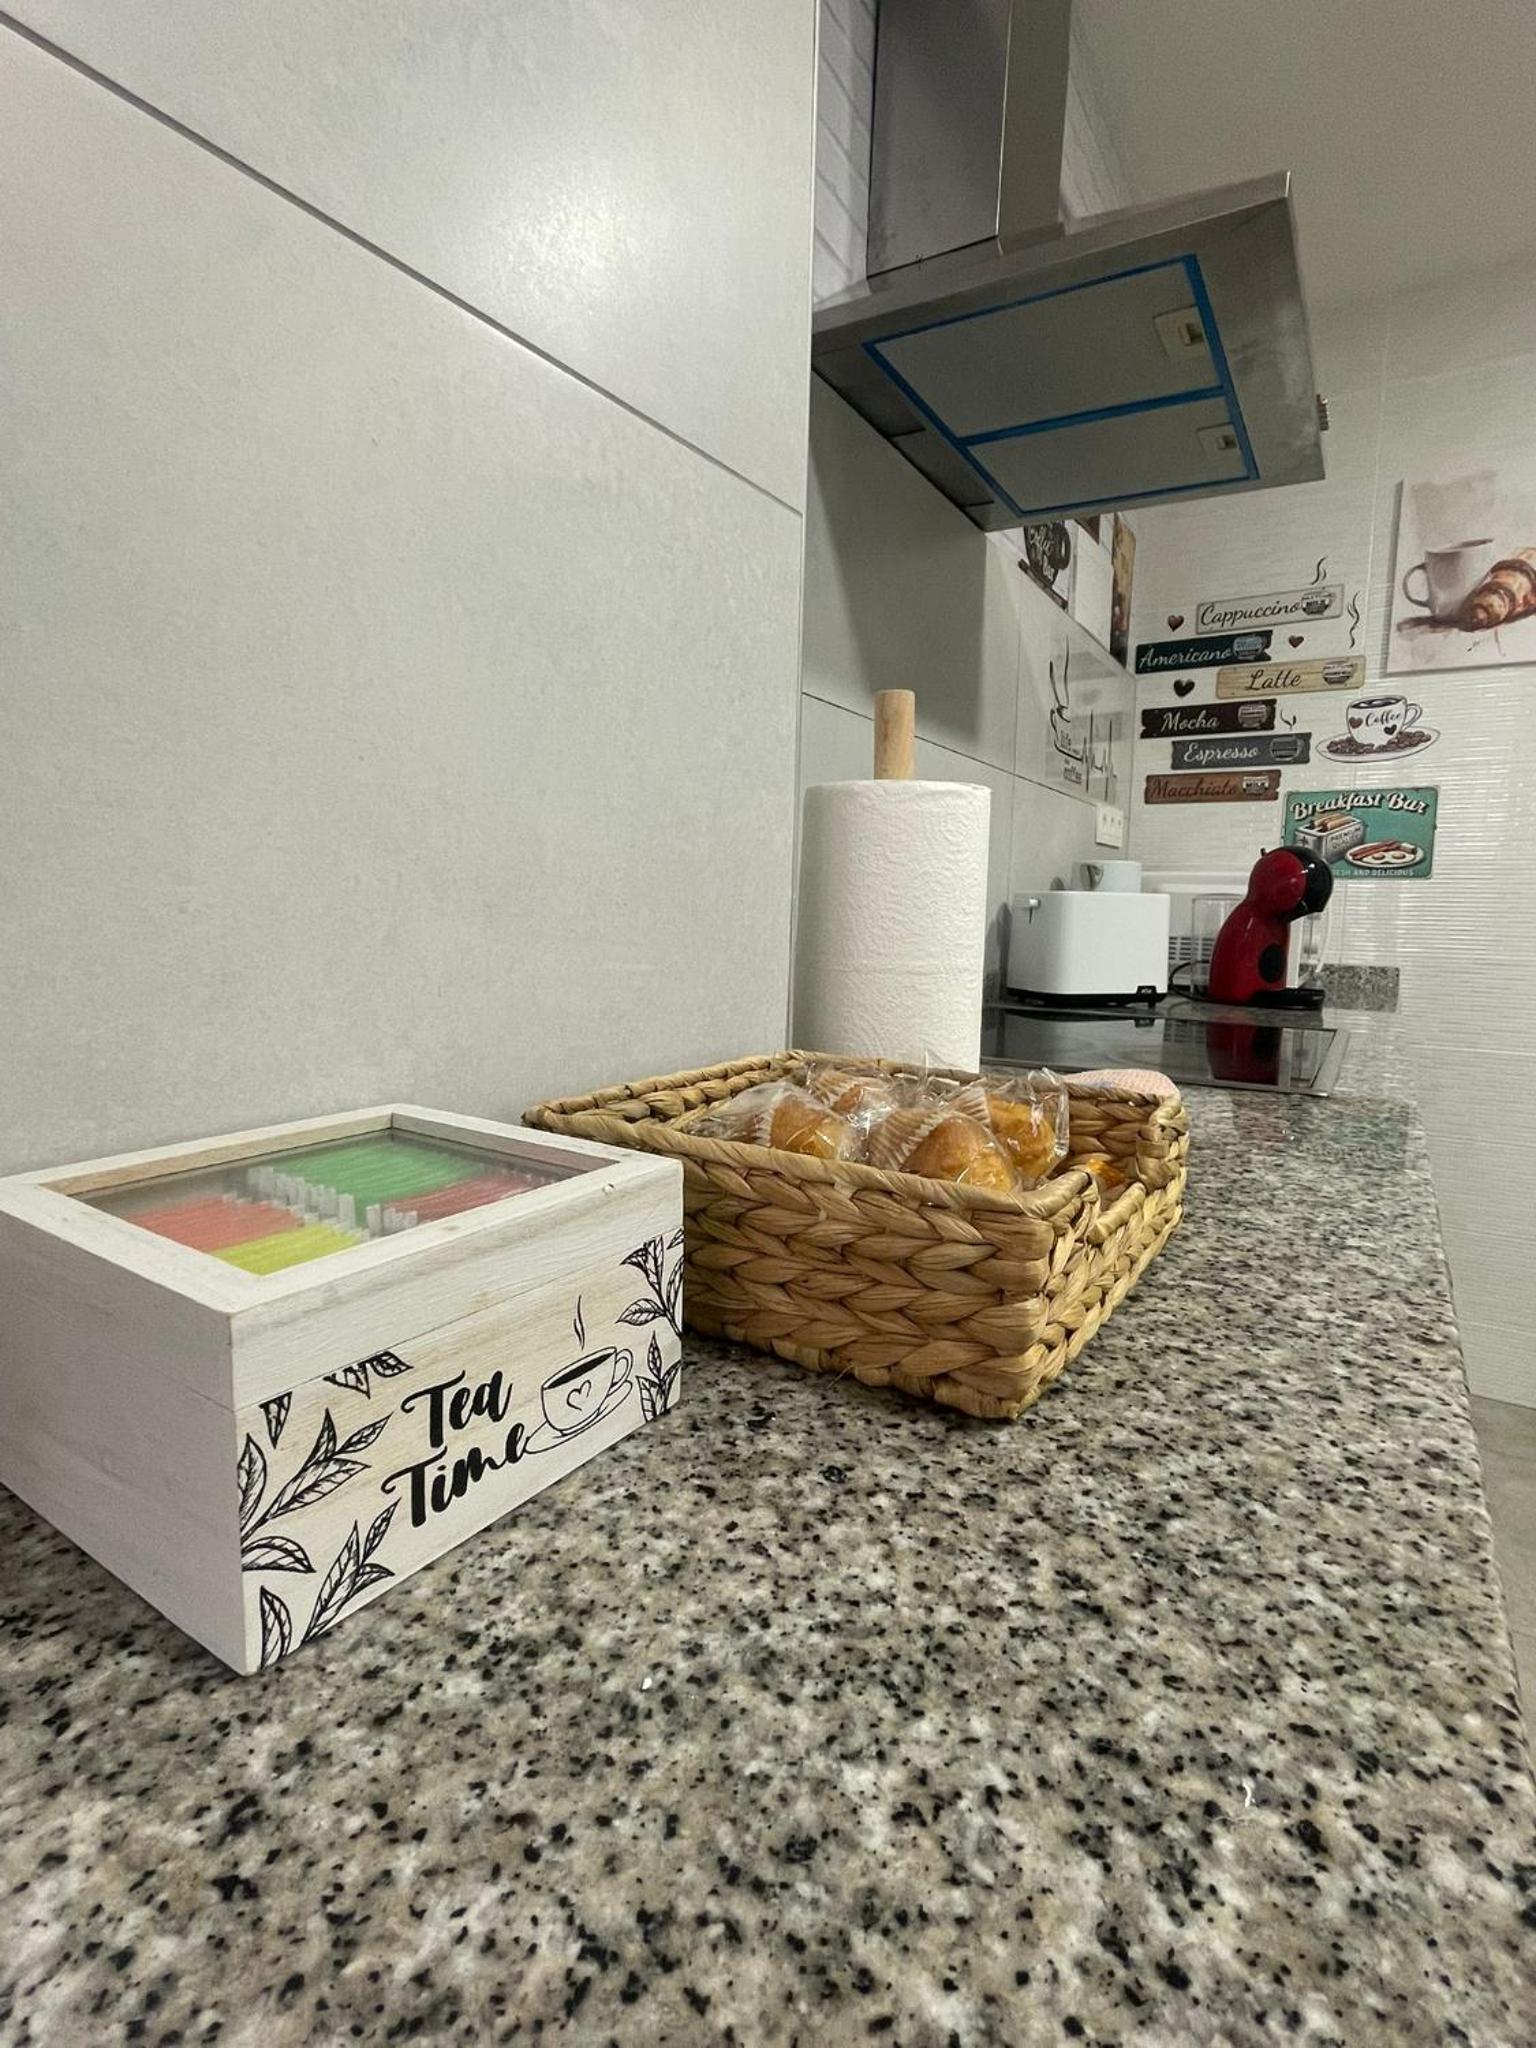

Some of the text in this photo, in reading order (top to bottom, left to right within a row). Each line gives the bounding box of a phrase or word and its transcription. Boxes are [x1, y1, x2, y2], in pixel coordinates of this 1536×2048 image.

[1200, 601, 1300, 627] Cappuccino
[1139, 647, 1232, 669] Americano
[1245, 669, 1301, 691] Latte
[1161, 709, 1220, 732] Mocha
[1184, 742, 1259, 765] Espresso
[1151, 777, 1240, 799] Macchiato
[1290, 791, 1428, 820] Breakfast Bar
[1354, 869, 1371, 877] AND
[1371, 869, 1415, 877] DELICIOUS
[401, 1370, 514, 1448] Tea
[381, 1422, 530, 1528] Time
